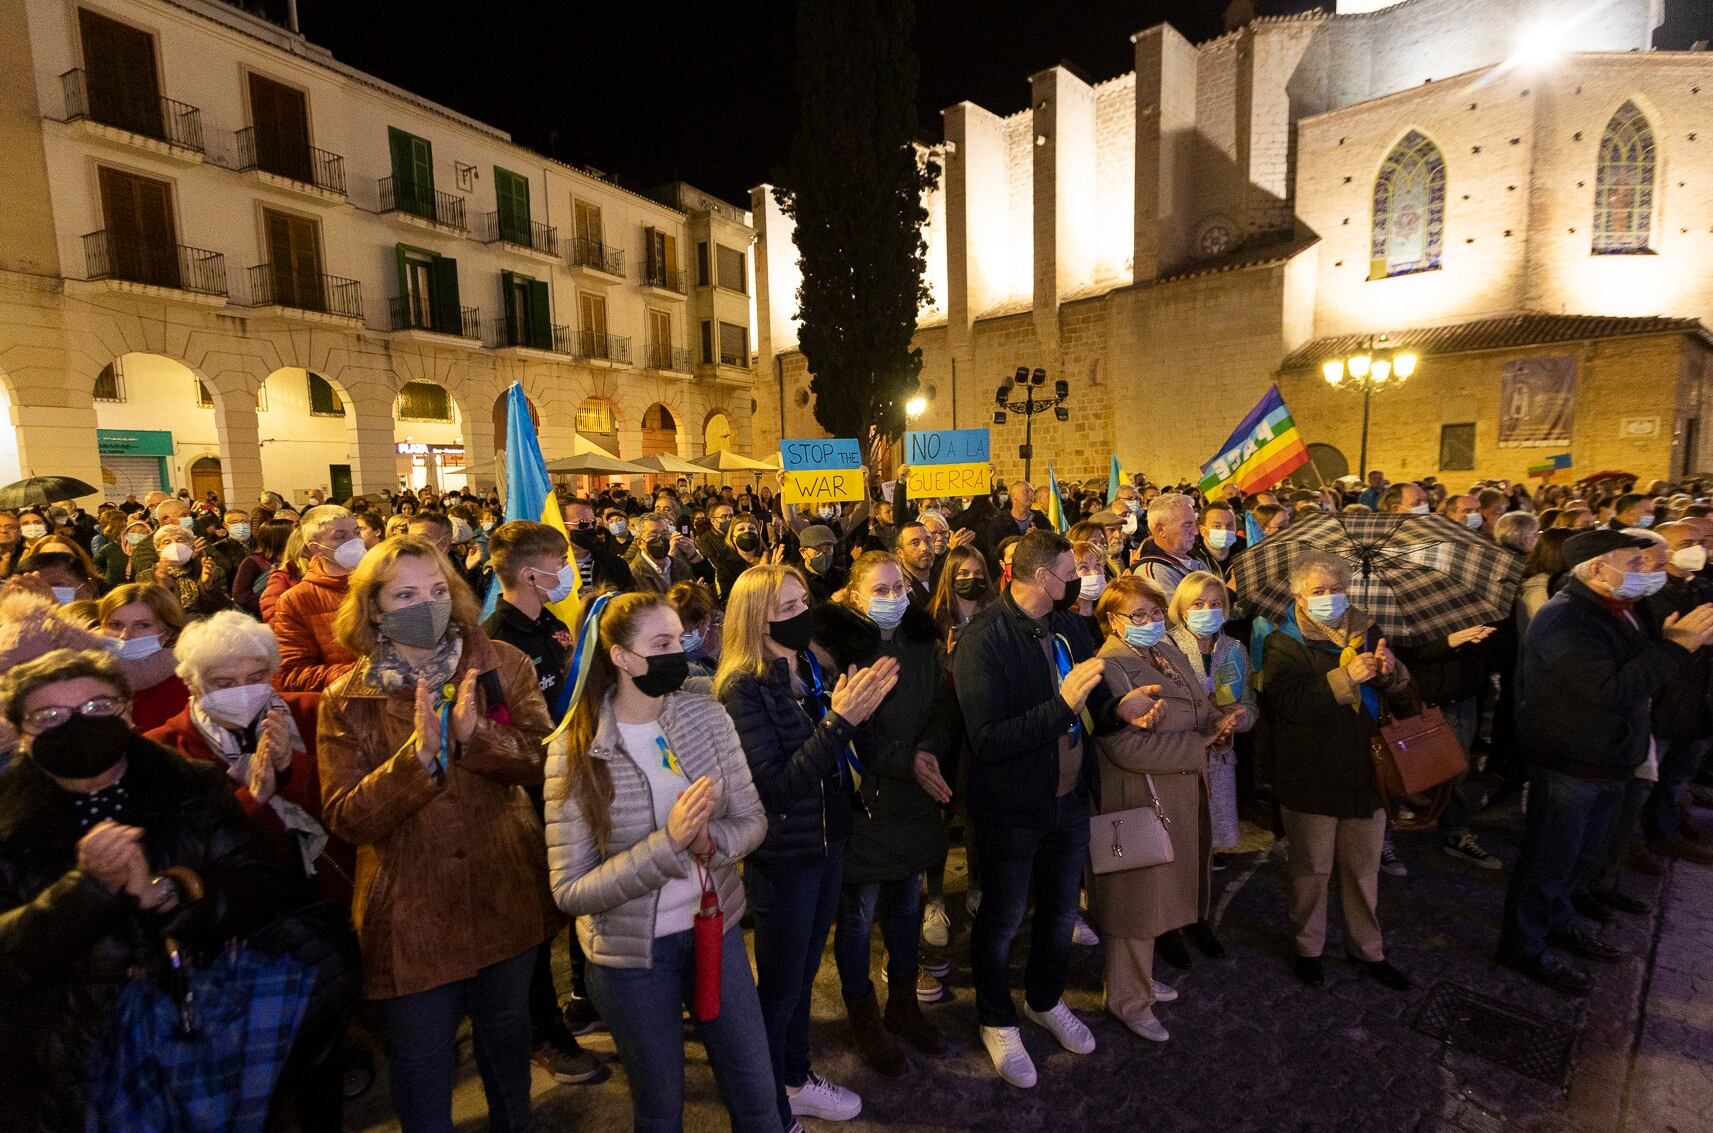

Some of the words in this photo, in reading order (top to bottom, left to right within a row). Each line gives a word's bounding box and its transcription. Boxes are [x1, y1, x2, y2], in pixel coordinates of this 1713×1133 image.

[787, 443, 834, 465] STOP
[837, 452, 859, 464] THE
[912, 433, 941, 462] NO
[946, 440, 957, 457] A
[966, 439, 986, 458] LA
[795, 475, 848, 497] WAR
[908, 468, 985, 492] GUERRA
